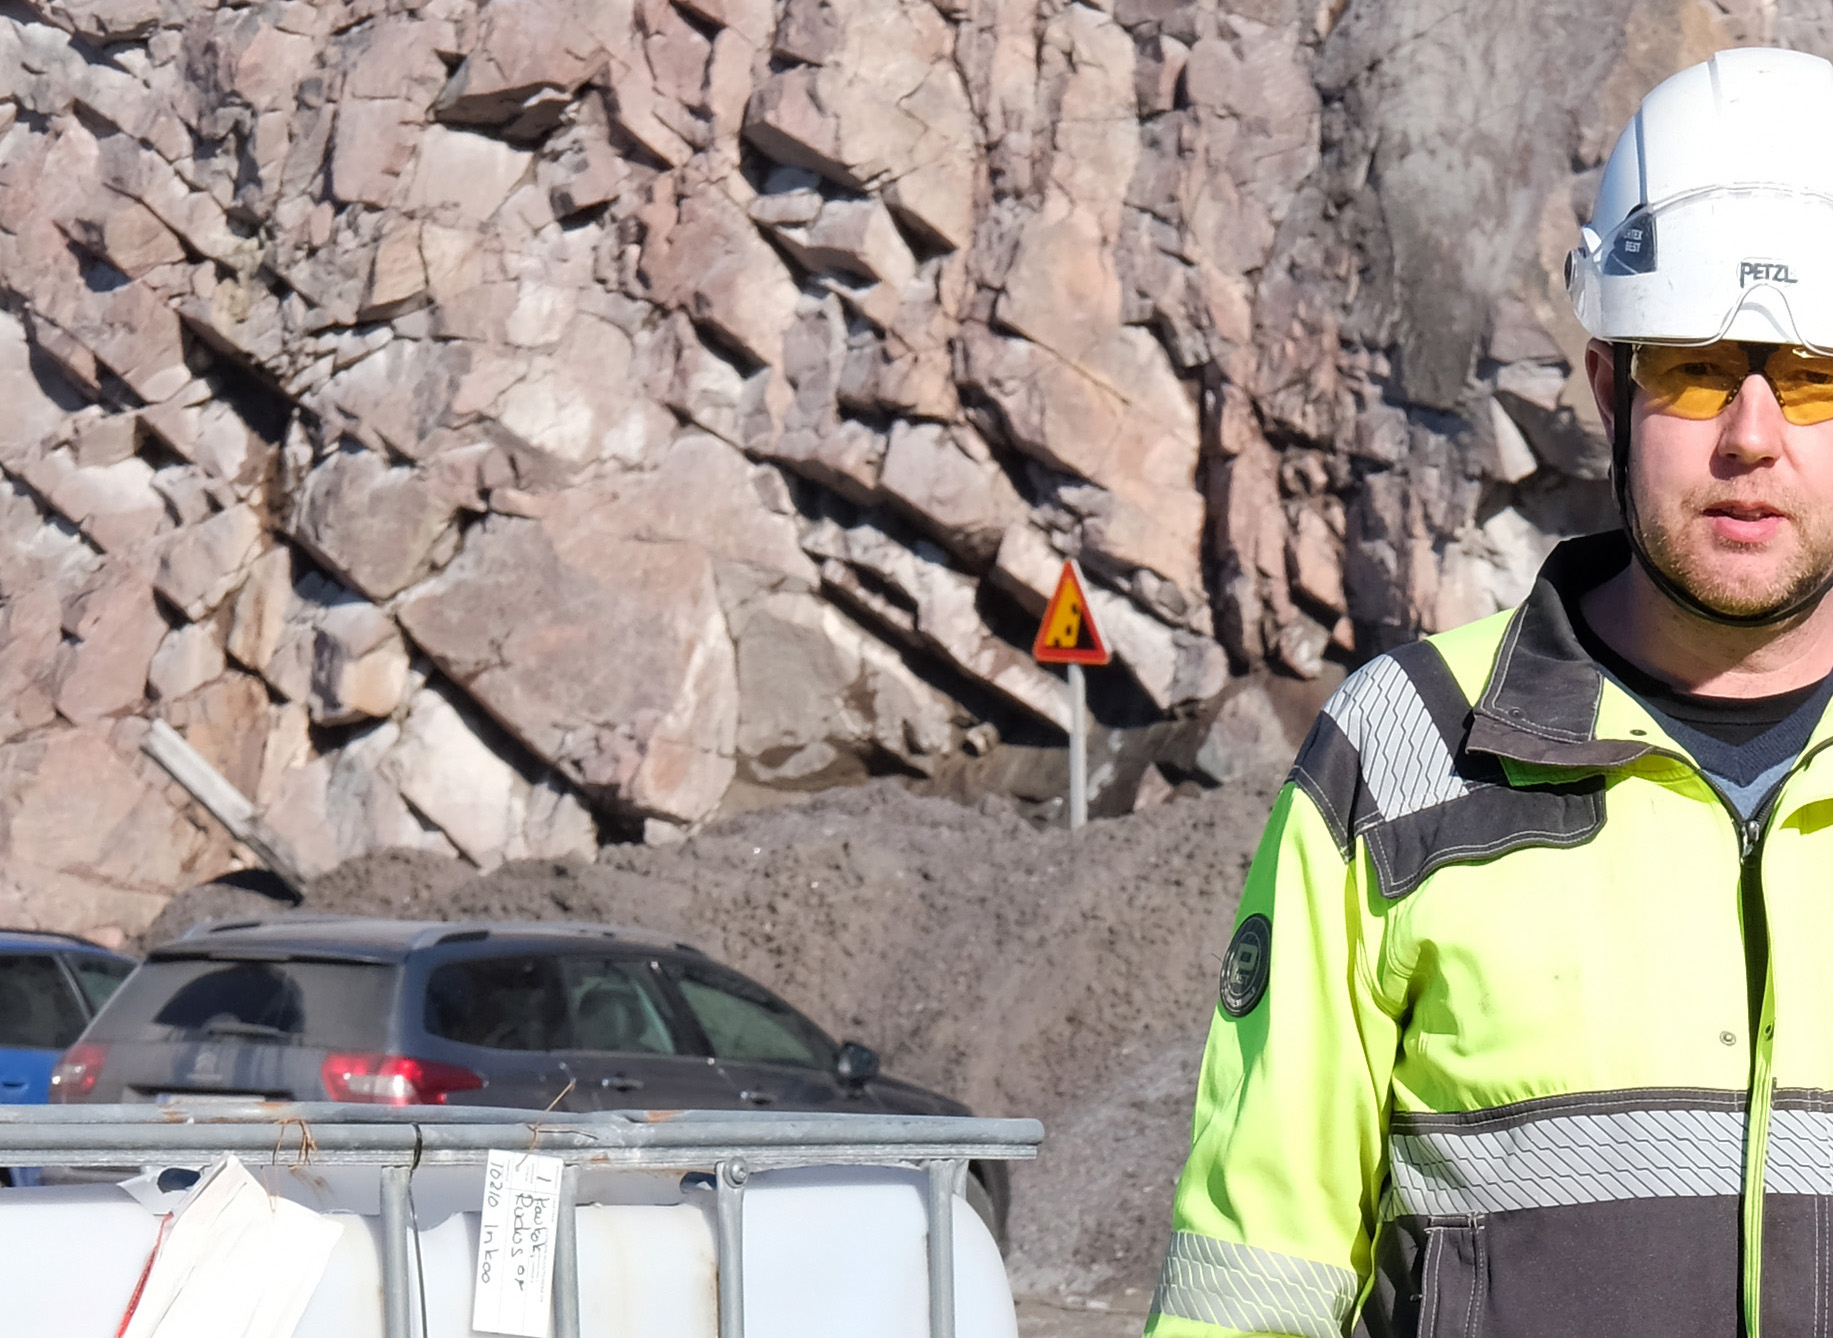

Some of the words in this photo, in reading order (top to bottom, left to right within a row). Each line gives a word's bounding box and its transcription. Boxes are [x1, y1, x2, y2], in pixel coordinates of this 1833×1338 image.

[1740, 261, 1799, 289] PETZL
[487, 1161, 504, 1208] 10210
[481, 1224, 500, 1284] Inkoo
